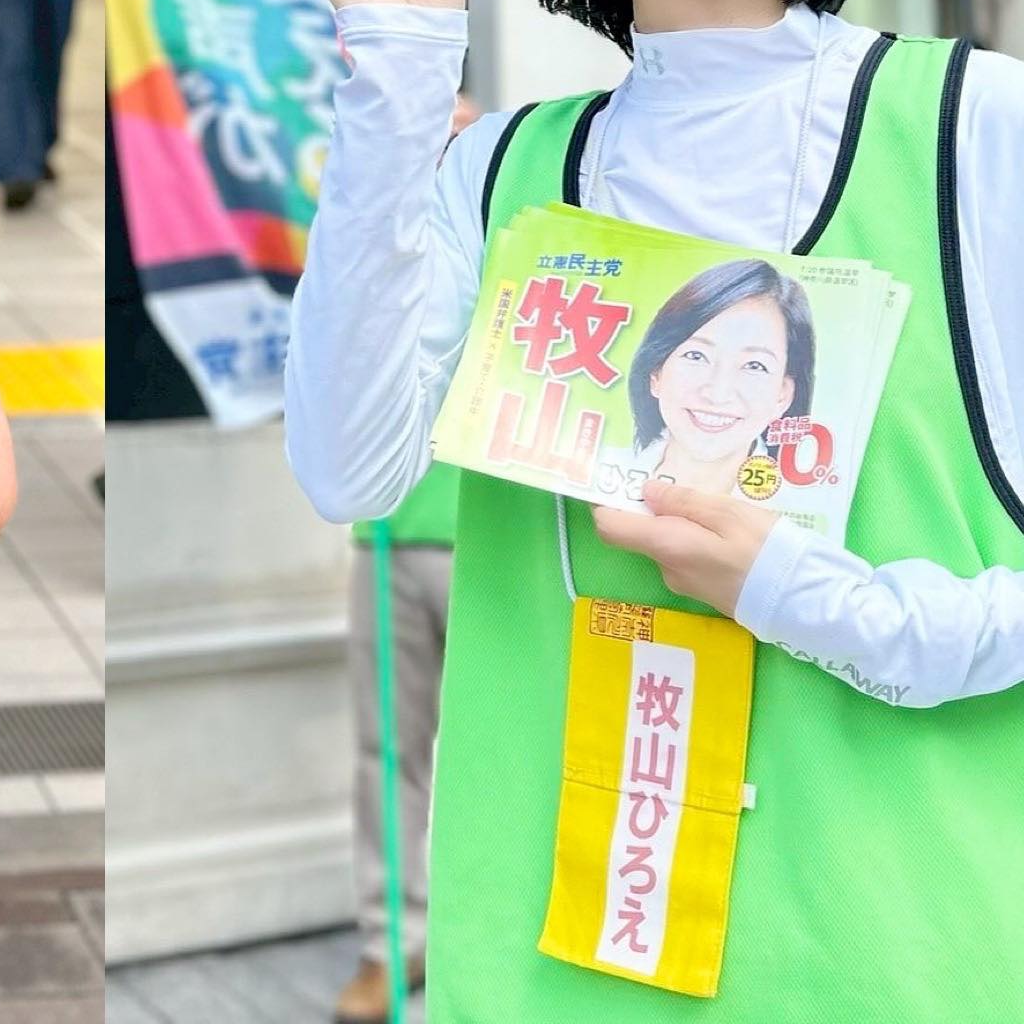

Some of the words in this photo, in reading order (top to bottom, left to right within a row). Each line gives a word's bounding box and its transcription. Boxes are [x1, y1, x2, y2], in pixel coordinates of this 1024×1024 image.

[536, 253, 623, 277] 立憲民主党
[488, 277, 630, 484] 牧山
[596, 462, 677, 502] ひろ
[742, 468, 777, 487] 25円
[610, 672, 684, 954] 牧山ひろえ
